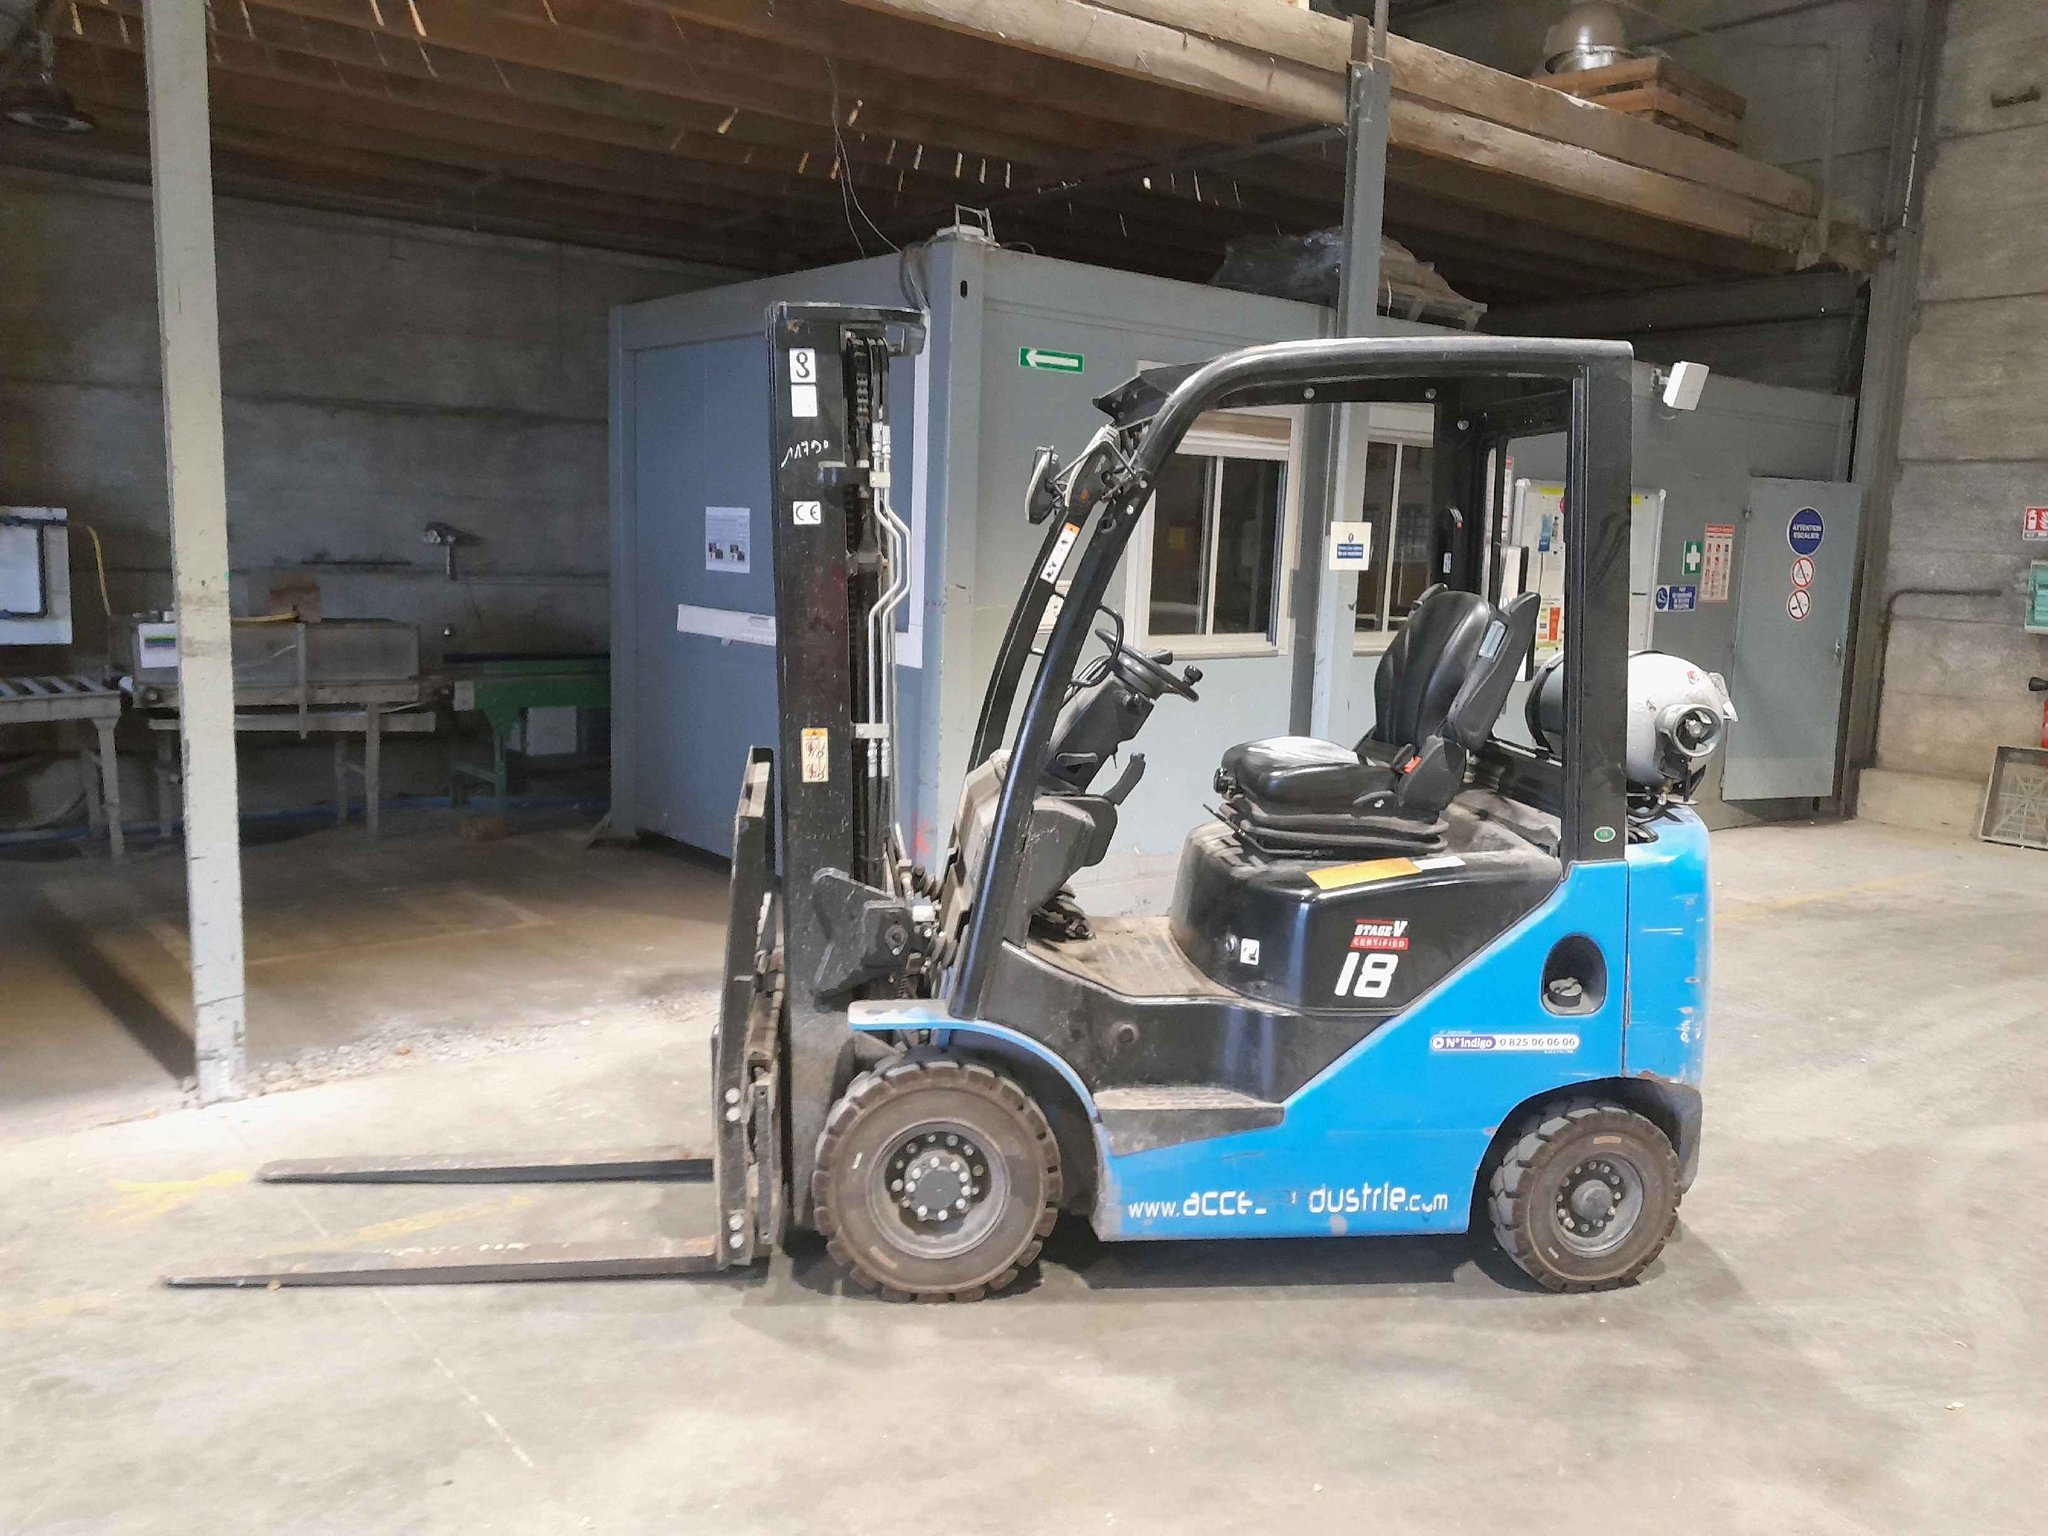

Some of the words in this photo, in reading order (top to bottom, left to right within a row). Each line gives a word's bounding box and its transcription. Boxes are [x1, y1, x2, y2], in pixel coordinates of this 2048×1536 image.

[1353, 938, 1405, 948] CERTIFIED
[1334, 952, 1399, 998] 18
[1509, 1038, 1528, 1047] 825
[1531, 1038, 1544, 1047] 06
[1547, 1038, 1560, 1047] 06
[1562, 1038, 1575, 1047] 06
